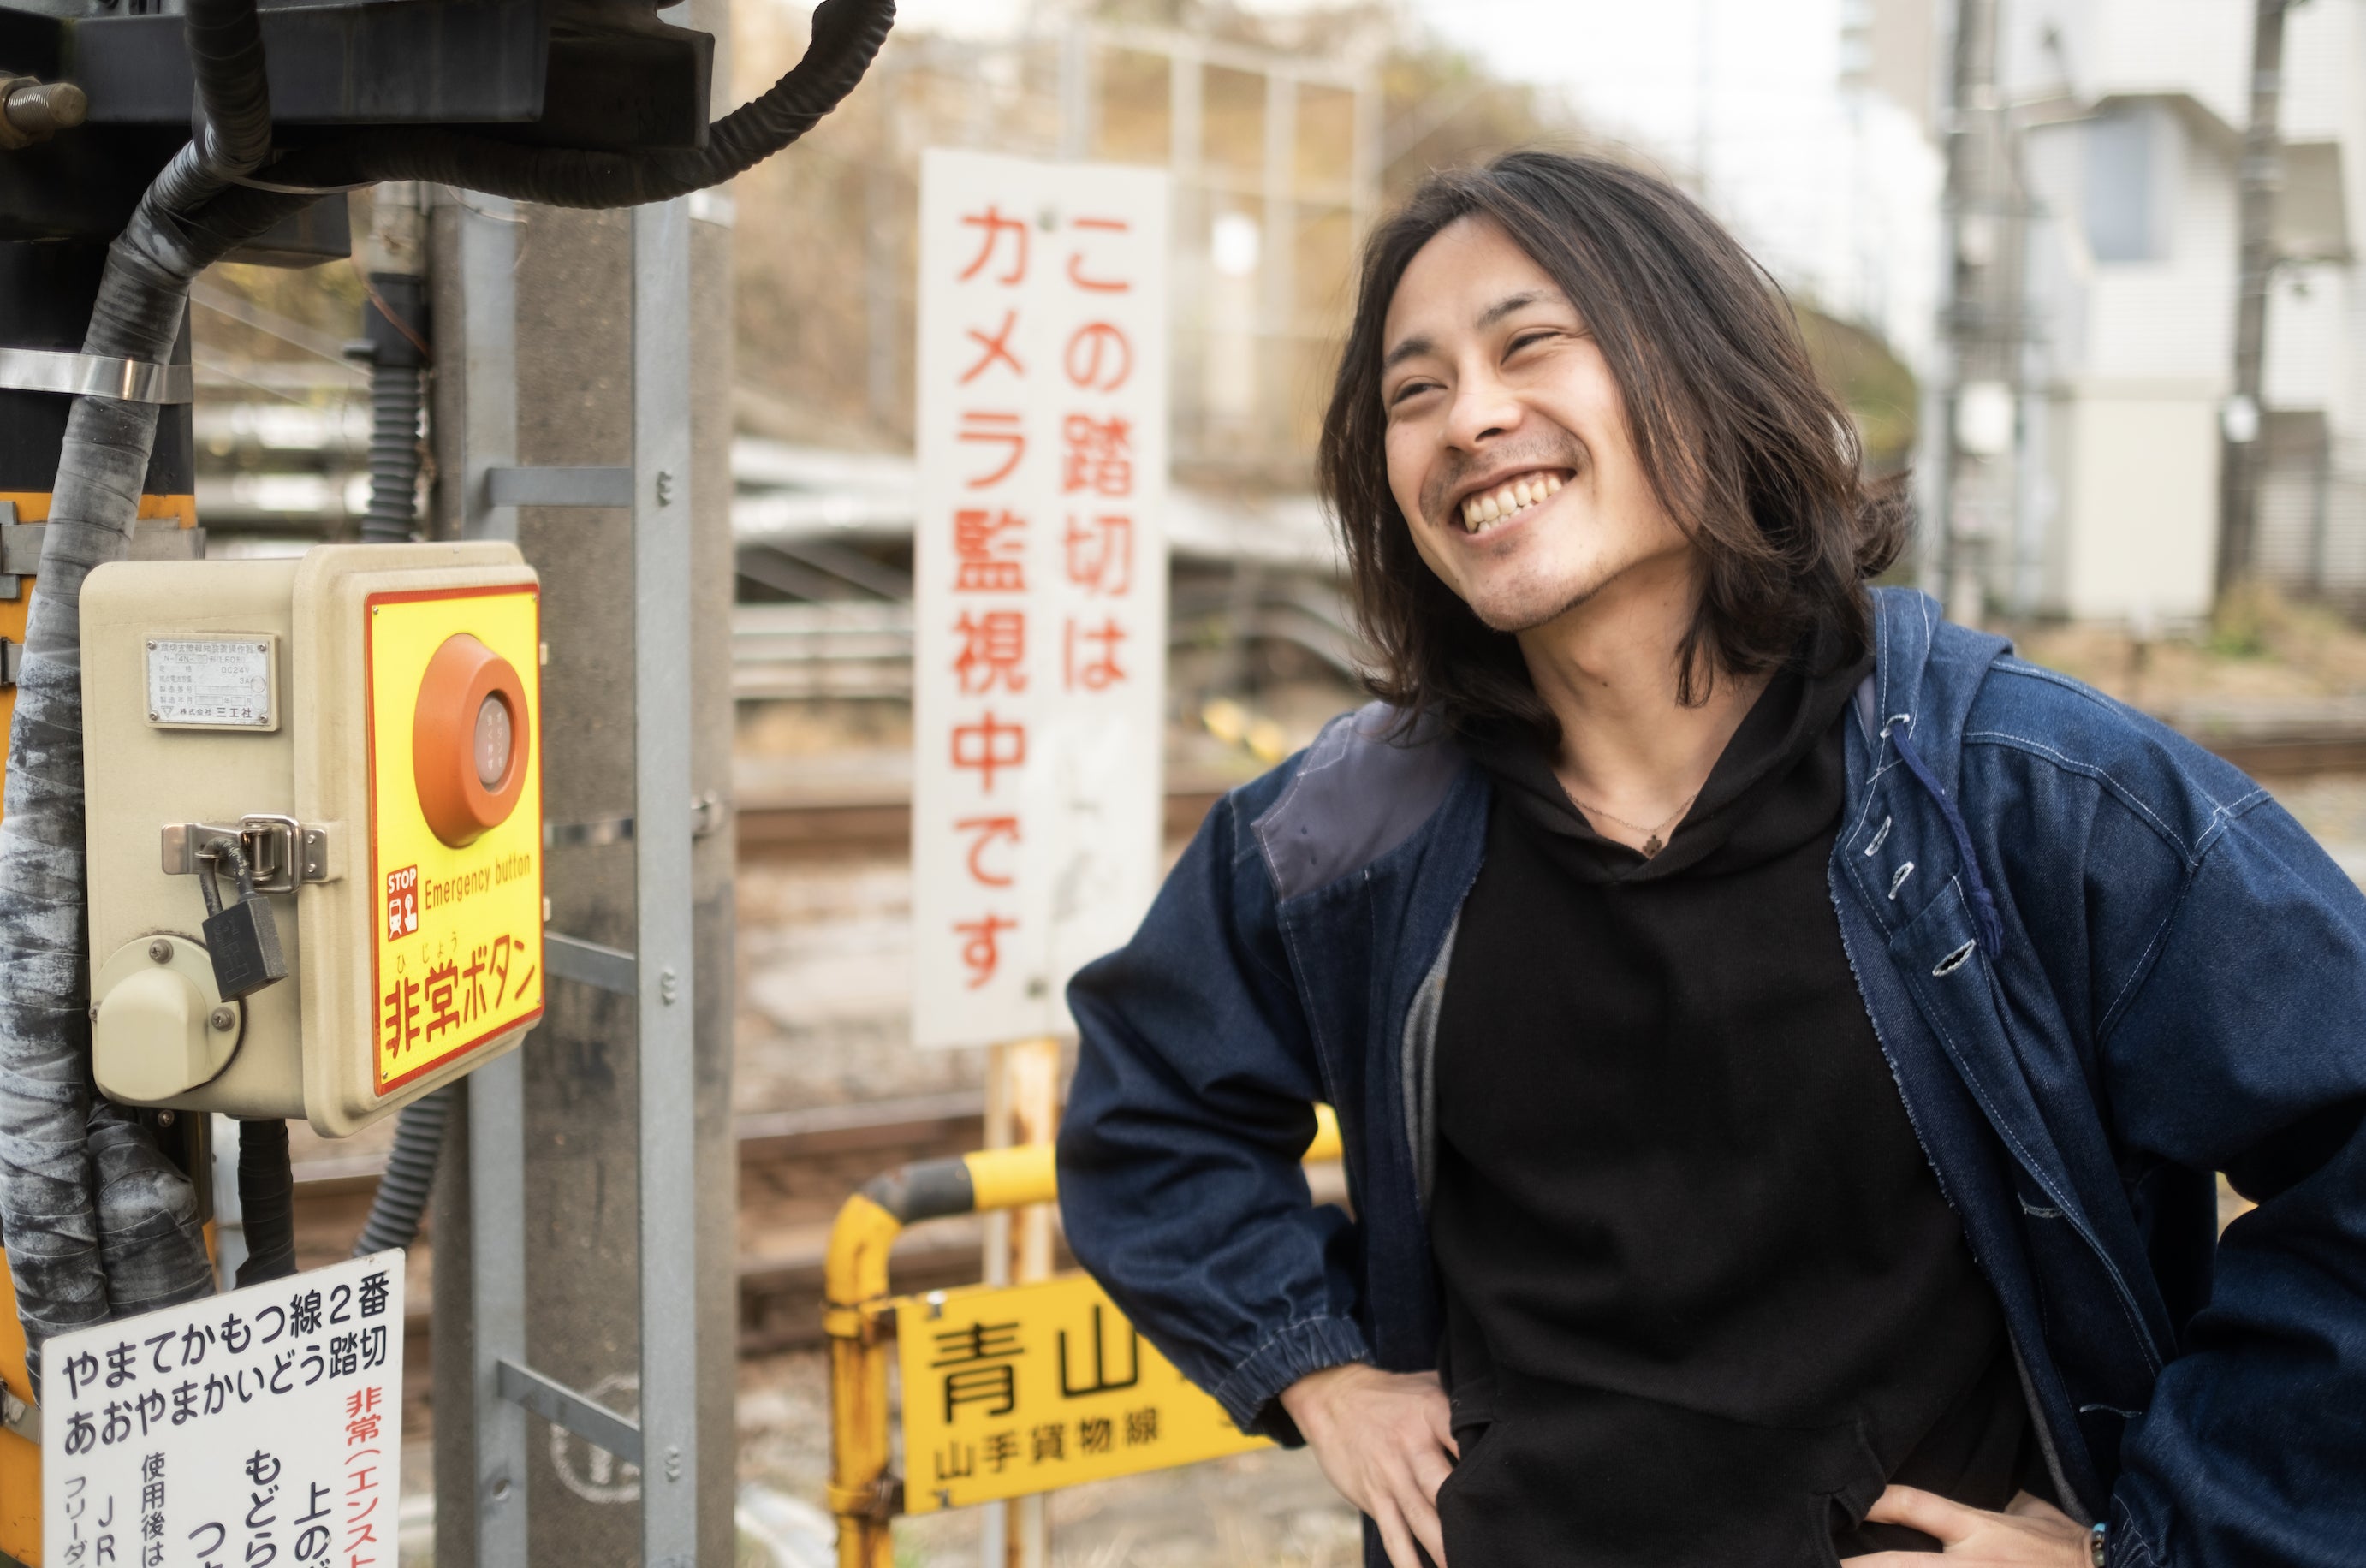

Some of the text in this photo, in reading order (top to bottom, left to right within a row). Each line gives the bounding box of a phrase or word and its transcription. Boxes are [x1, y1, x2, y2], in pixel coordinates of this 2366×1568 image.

[1062, 216, 1133, 695] この踏切は
[954, 205, 1030, 993] カメラ監視中です
[221, 666, 250, 674] DC24V
[388, 867, 418, 894] STOP
[425, 853, 531, 911] Emergency button
[384, 934, 536, 1059] 非常ボタン
[62, 1271, 390, 1400] やまてかもつ線2番
[929, 1304, 1140, 1425] 青山
[64, 1324, 388, 1455] あおやまかいどう踏切
[933, 1406, 1161, 1482] 山手貨物線
[64, 1476, 88, 1568] フリーダ
[96, 1495, 116, 1567] JR
[140, 1452, 166, 1568] 使用後は
[187, 1522, 226, 1568] つ
[245, 1449, 281, 1568] もどら
[294, 1481, 331, 1568] 上の
